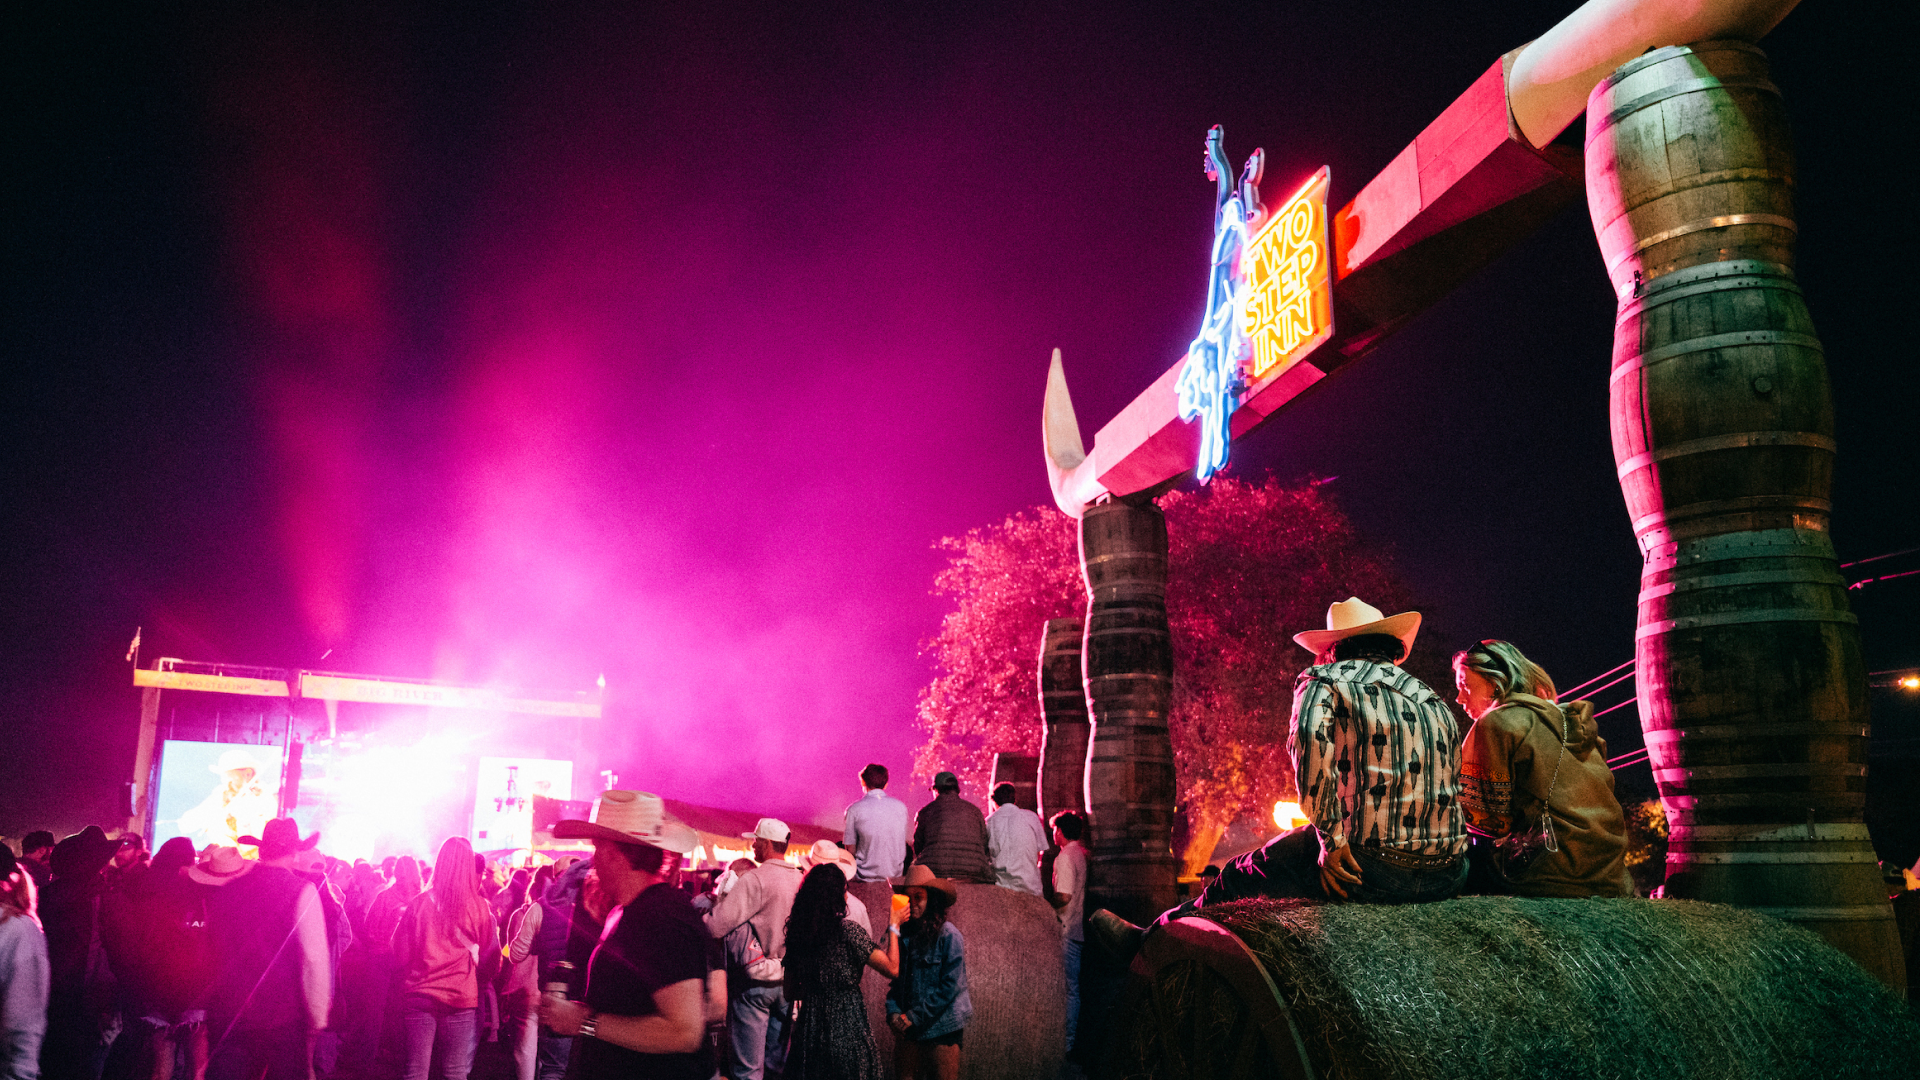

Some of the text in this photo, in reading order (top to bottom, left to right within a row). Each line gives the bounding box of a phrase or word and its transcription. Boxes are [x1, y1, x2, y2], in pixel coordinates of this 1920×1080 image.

[1241, 199, 1314, 291] TWO
[1245, 240, 1317, 337] STEP
[1252, 289, 1314, 377] INN
[356, 685, 443, 701] BIG RIVER
